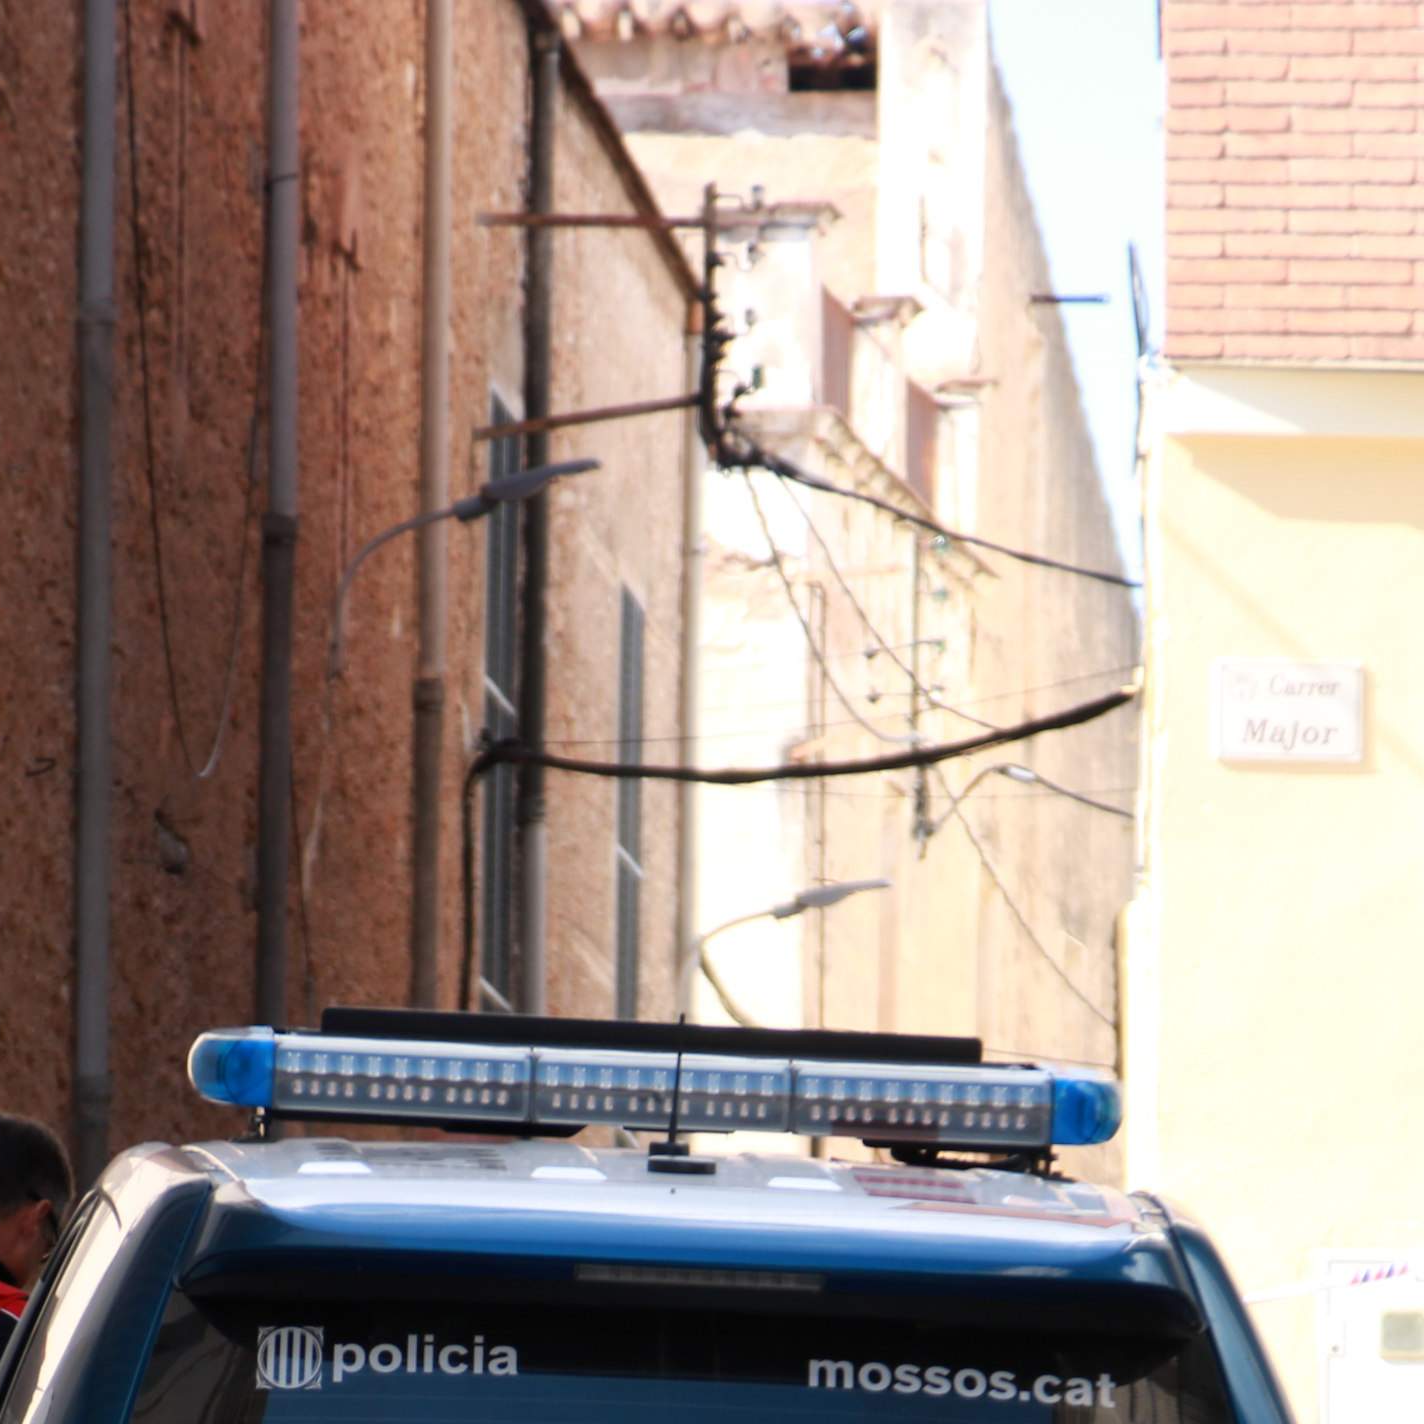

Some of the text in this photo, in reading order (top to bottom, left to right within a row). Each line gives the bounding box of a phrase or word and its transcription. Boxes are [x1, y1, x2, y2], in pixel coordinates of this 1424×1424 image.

[1269, 674, 1341, 697] Carrer
[1244, 718, 1339, 752] Major
[332, 1334, 519, 1383] policia
[807, 1358, 1116, 1409] mossos.cat
